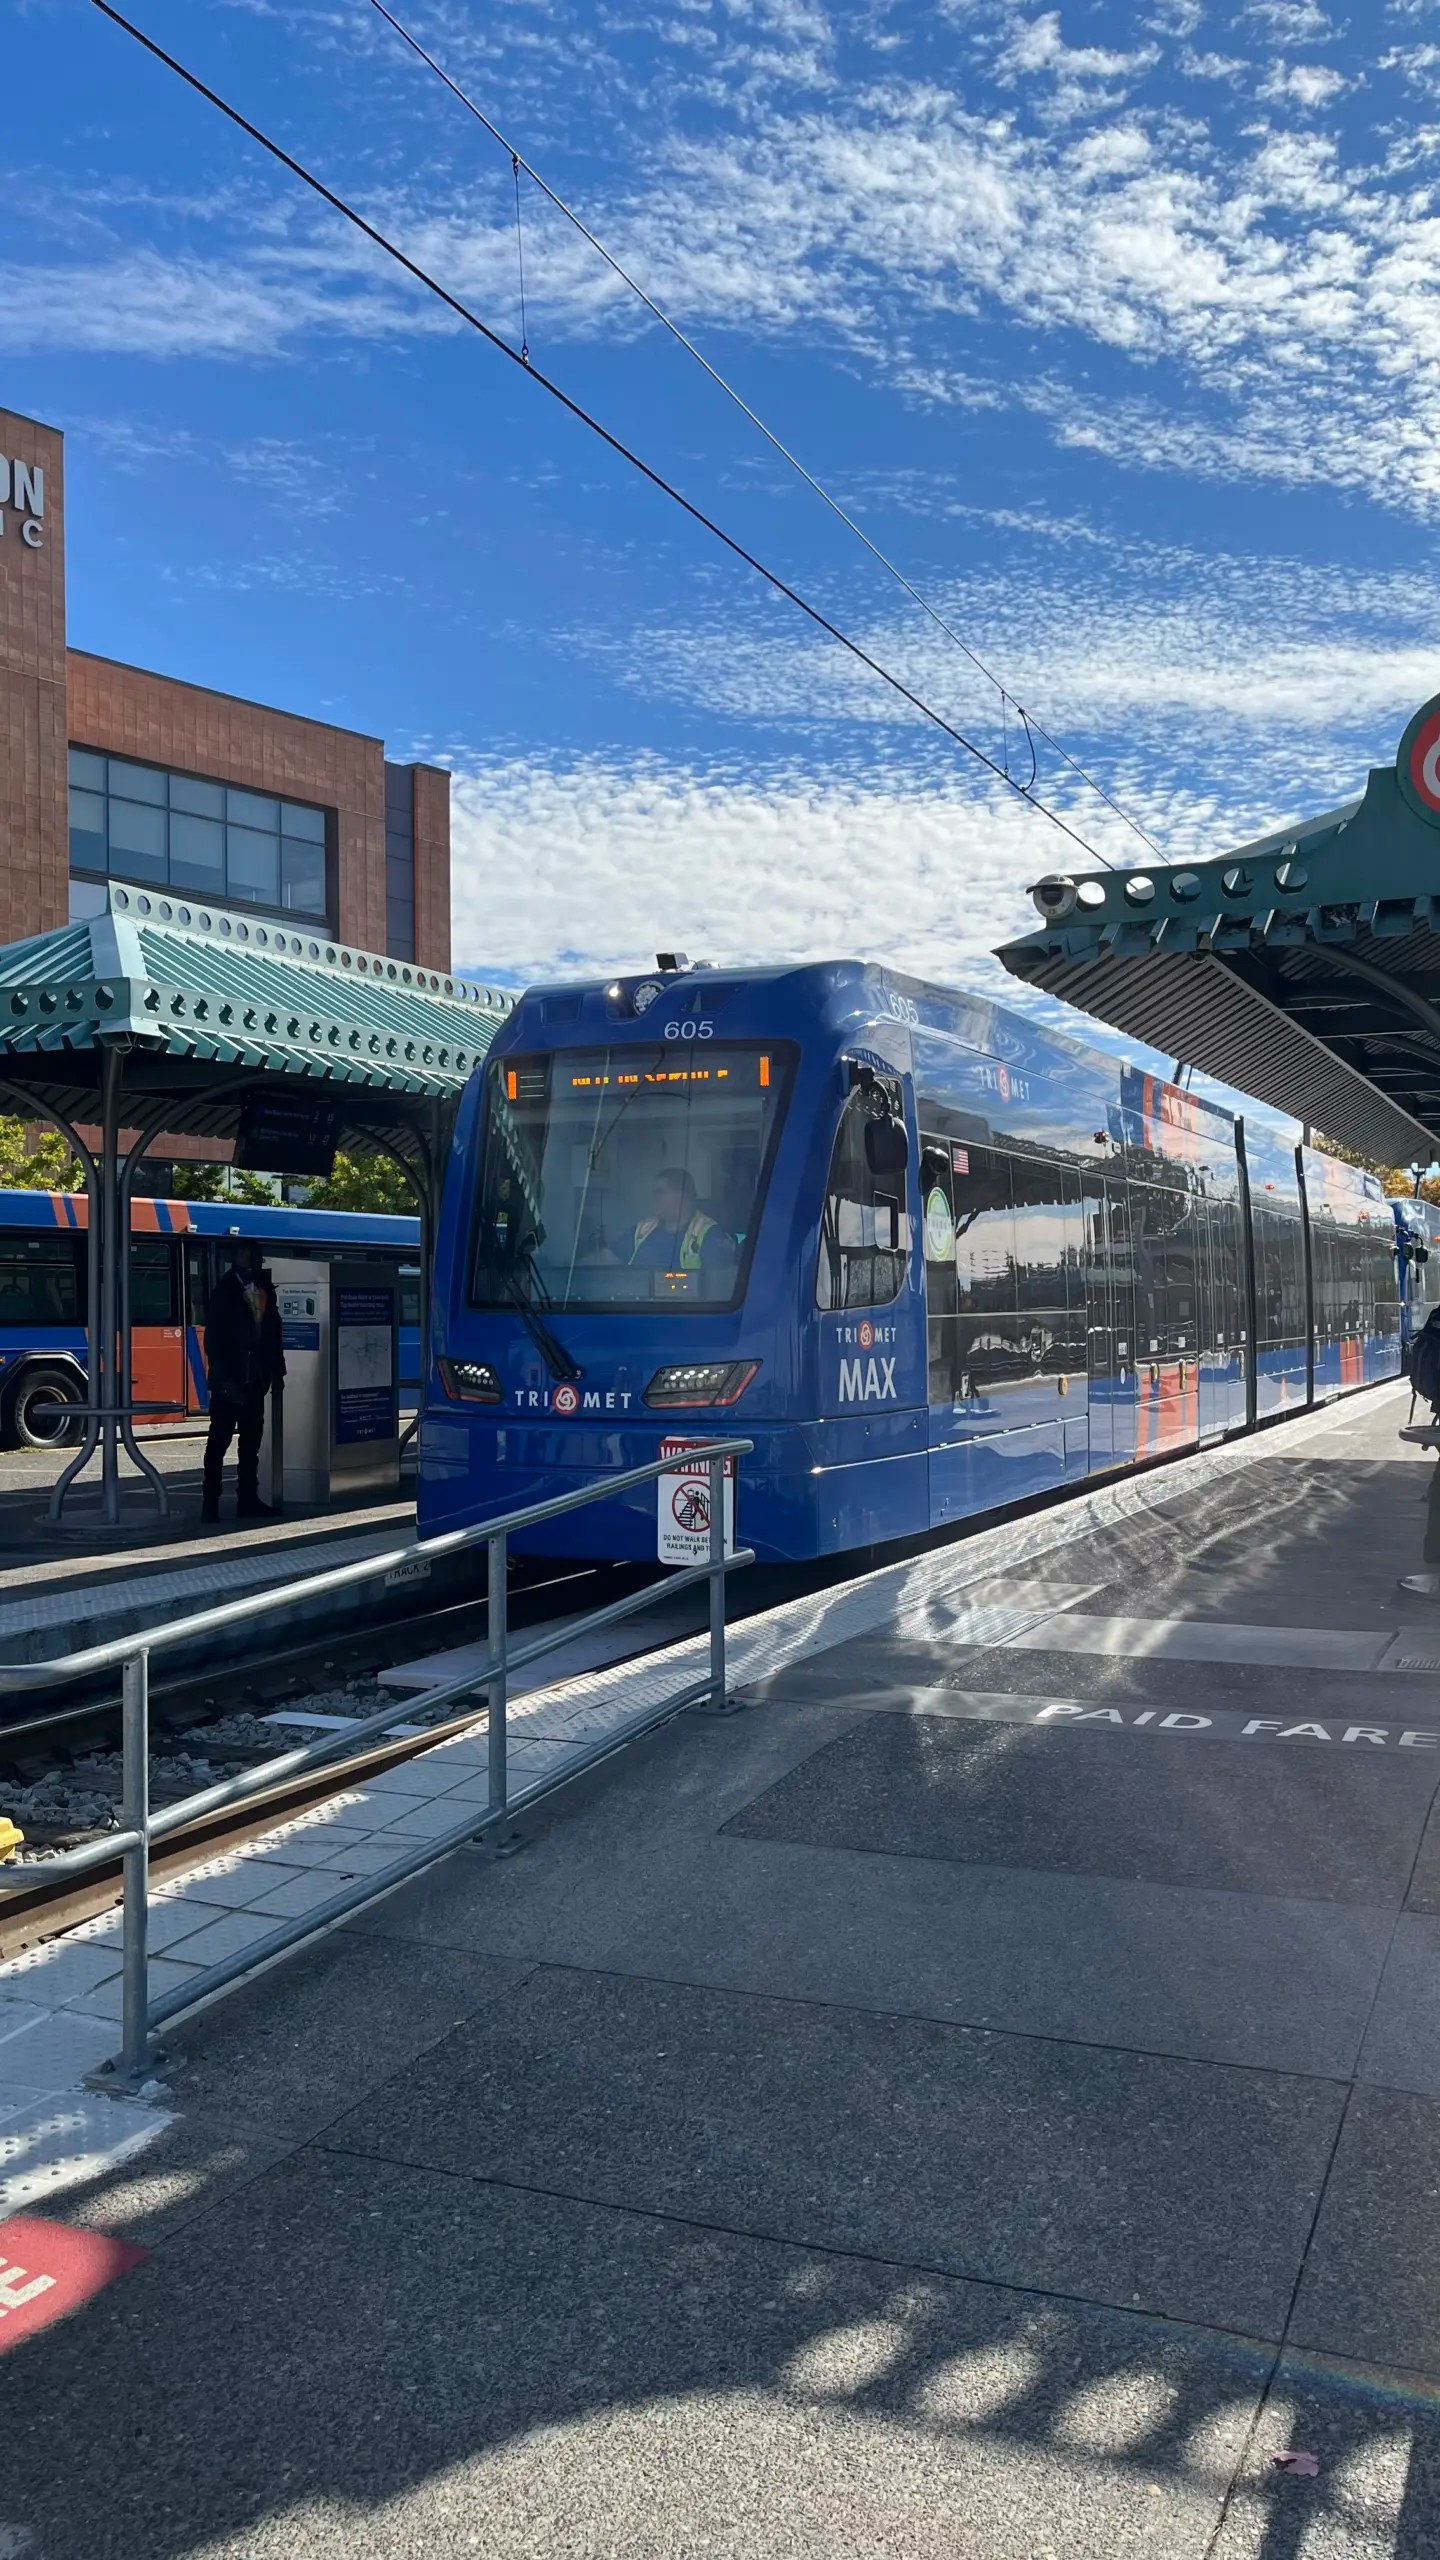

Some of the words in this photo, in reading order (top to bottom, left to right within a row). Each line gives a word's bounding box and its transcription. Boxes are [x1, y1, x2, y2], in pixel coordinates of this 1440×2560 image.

[889, 993, 919, 1024] 605
[664, 1020, 714, 1039] 605
[838, 1357, 897, 1402] MAX
[666, 1542, 692, 1551] RAILINGS
[693, 1544, 705, 1552] AND
[684, 1535, 700, 1543] WALK
[390, 1564, 420, 1579] RACK
[1035, 1704, 1213, 1730] PAID
[1240, 1719, 1440, 1749] FARE
